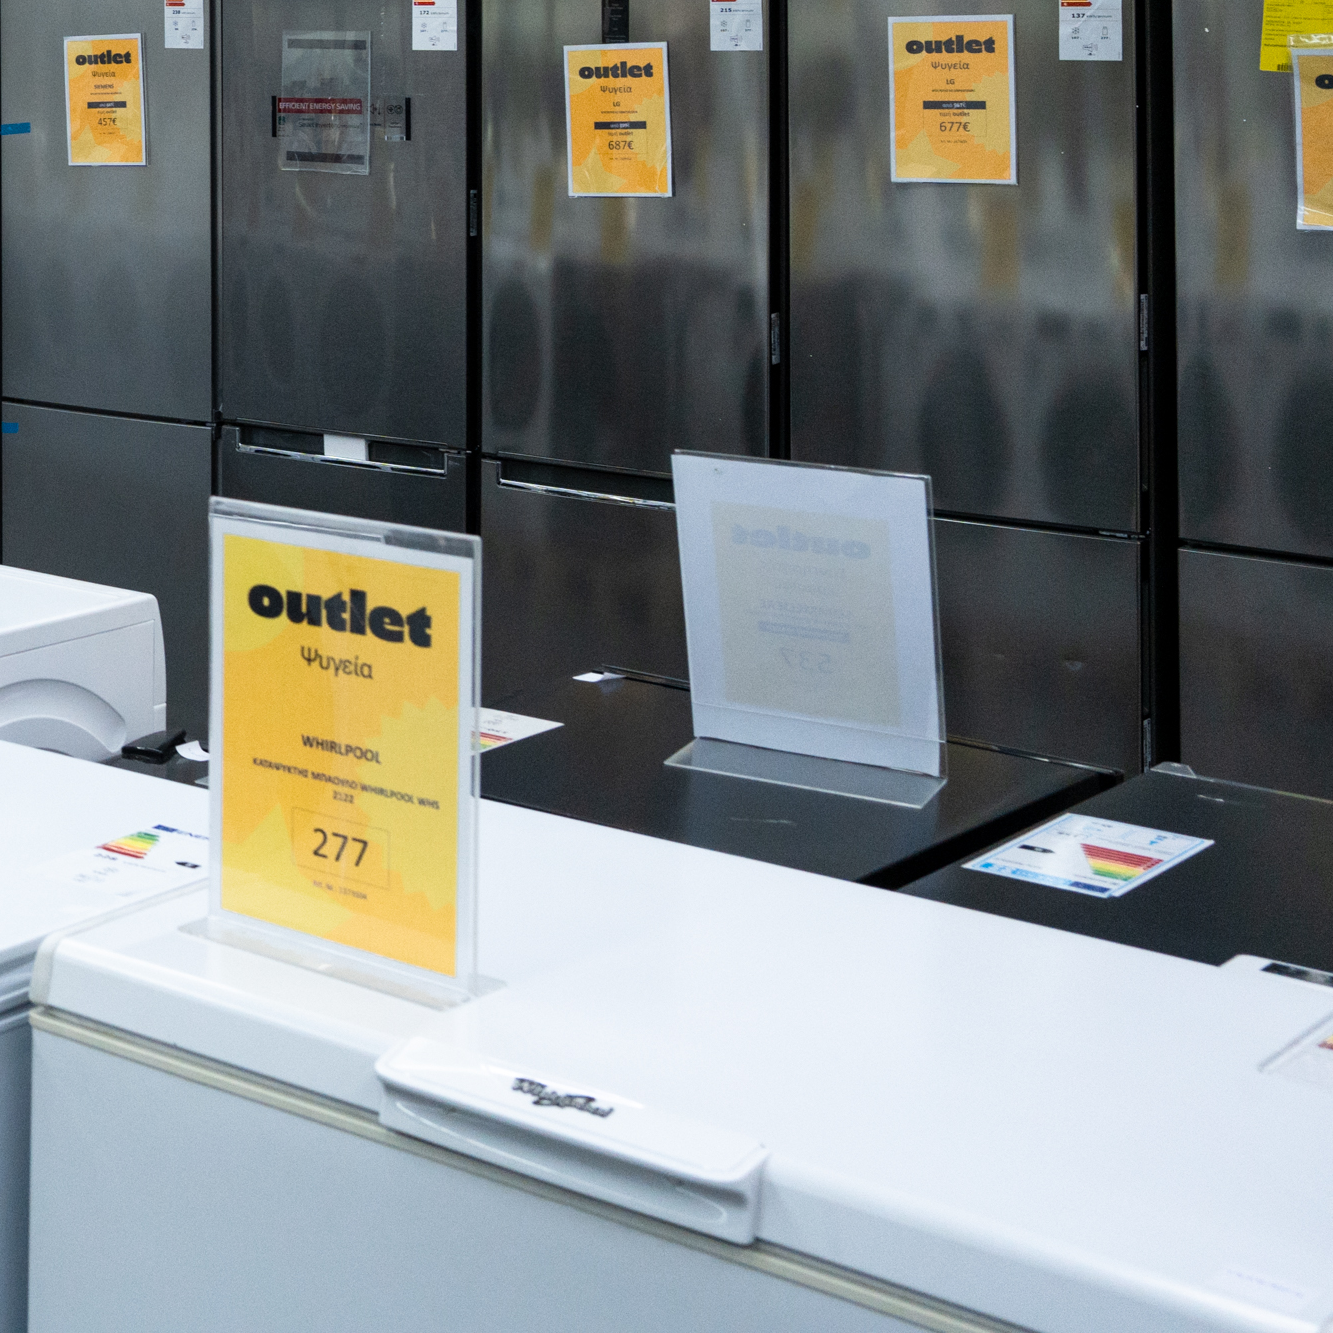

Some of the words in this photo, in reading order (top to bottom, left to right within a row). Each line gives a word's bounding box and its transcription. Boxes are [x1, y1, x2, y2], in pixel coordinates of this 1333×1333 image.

[905, 35, 996, 54] outlet
[75, 49, 132, 66] outlet
[931, 61, 970, 71] Ψυγεία
[91, 70, 116, 78] Ψυγεία
[578, 61, 654, 79] outlet
[600, 85, 632, 95] Ψυγεία
[97, 117, 118, 126] 457€
[939, 121, 971, 132] 677€
[608, 141, 634, 150] 687€
[248, 584, 432, 649] outlet
[300, 645, 373, 680] Ψυγεία
[301, 733, 382, 765] WHIRLPOOL
[252, 757, 309, 778] ΚΑΤΑΨΥΚΤΗΣ
[311, 771, 358, 790] ΜΠΑΟΥΛΟ
[360, 782, 415, 804] WHIRLPOOL
[417, 796, 440, 810] WHS
[313, 827, 369, 867] 277
